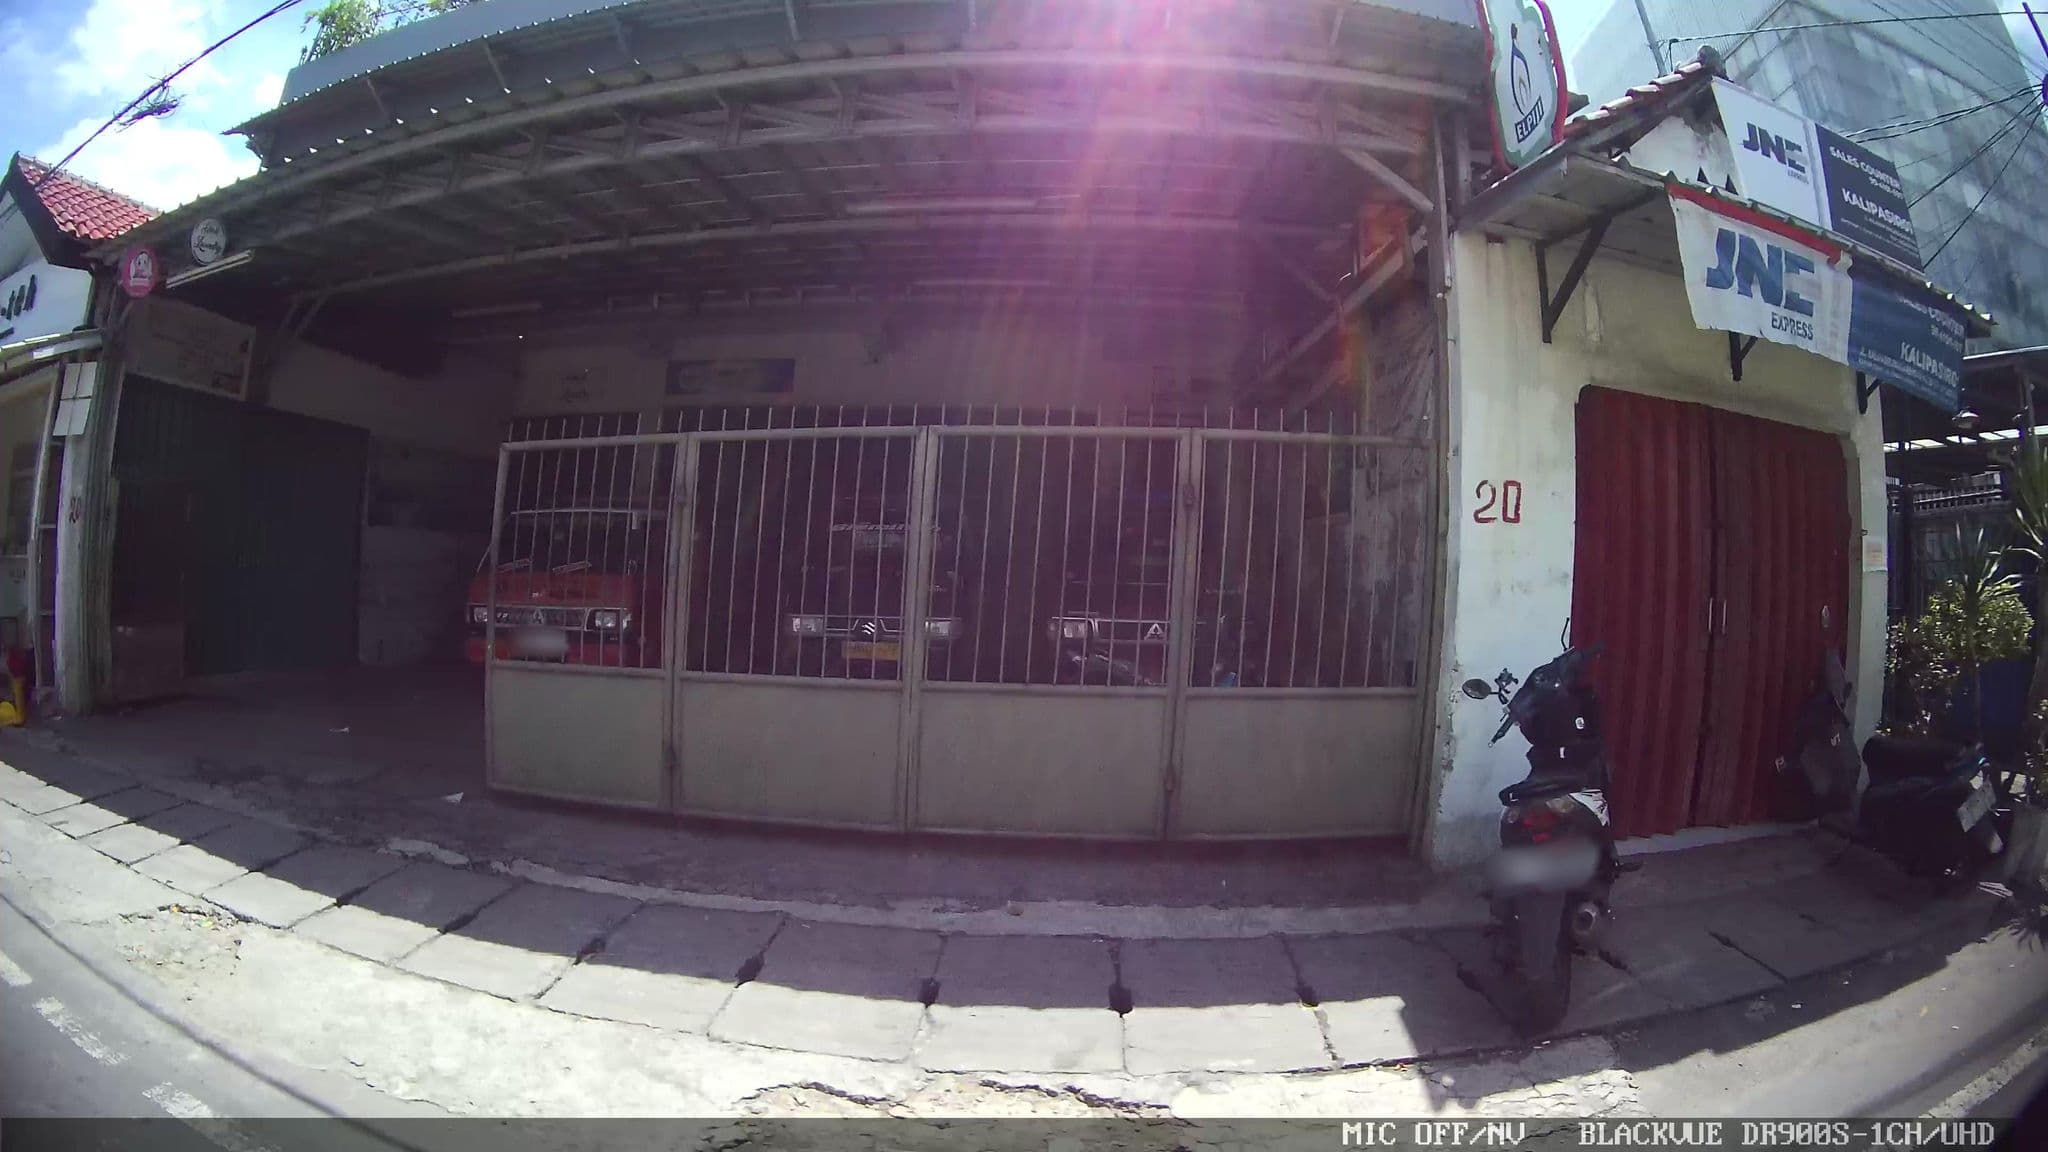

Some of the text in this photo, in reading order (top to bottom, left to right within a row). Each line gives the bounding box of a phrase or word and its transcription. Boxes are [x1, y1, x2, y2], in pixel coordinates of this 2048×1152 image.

[1742, 122, 1805, 174] JNE
[1829, 146, 1860, 169] SALES
[1706, 228, 1815, 317] JNE
[1771, 311, 1814, 341] EXPRESS
[1473, 480, 1522, 524] 20
